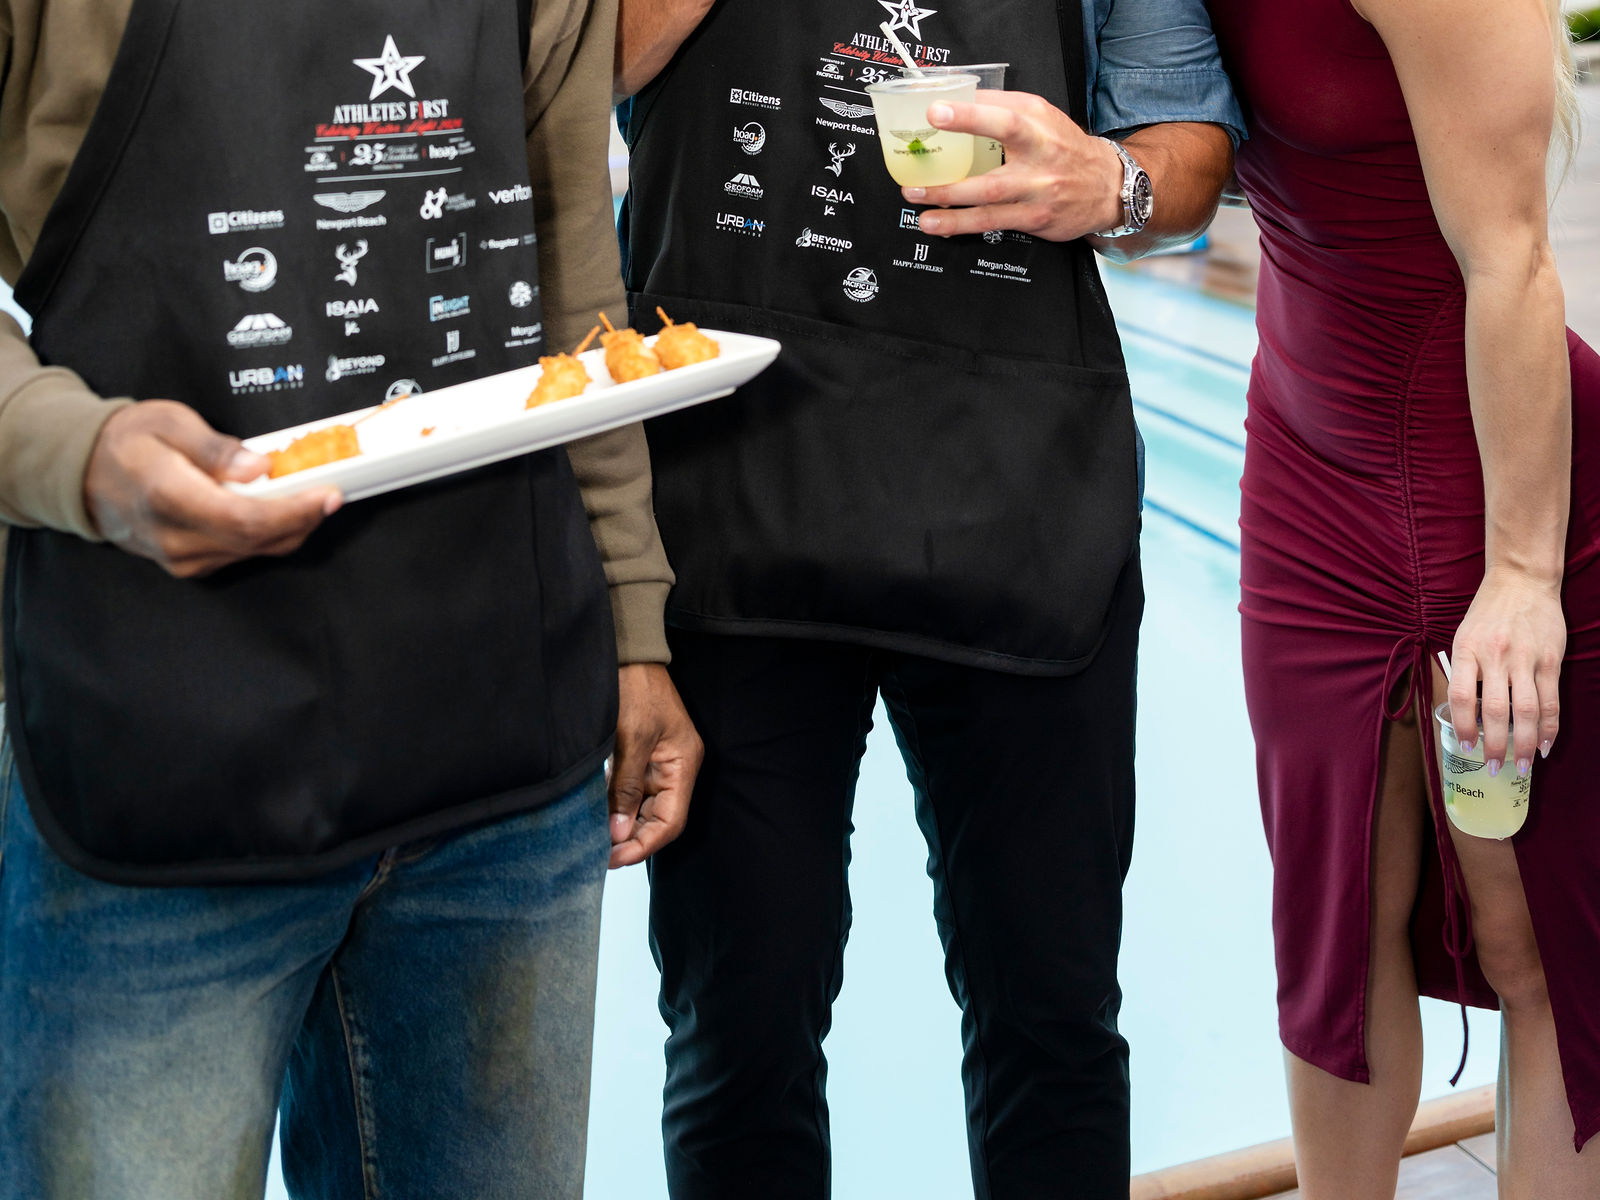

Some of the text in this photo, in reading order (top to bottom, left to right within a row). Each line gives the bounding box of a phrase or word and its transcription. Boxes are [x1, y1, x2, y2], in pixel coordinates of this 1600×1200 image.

[850, 32, 912, 56] ATHLETS
[743, 91, 781, 106] Citizens
[333, 102, 406, 125] ATHLETES
[815, 117, 875, 135] Newport Beach
[724, 181, 764, 196] GEOFOAM
[811, 185, 855, 204] ISAIA
[228, 210, 285, 226] Citizens
[716, 212, 766, 232] URBAN
[811, 233, 853, 249] BEYOND
[892, 259, 944, 273] HAPPY JEWELERS
[977, 258, 1028, 275] Morgan Stanley
[843, 279, 880, 293] PACIFIC LIFE
[325, 298, 380, 317] ISAIA
[229, 363, 305, 387] URBAN
[1456, 783, 1485, 798] Beach
